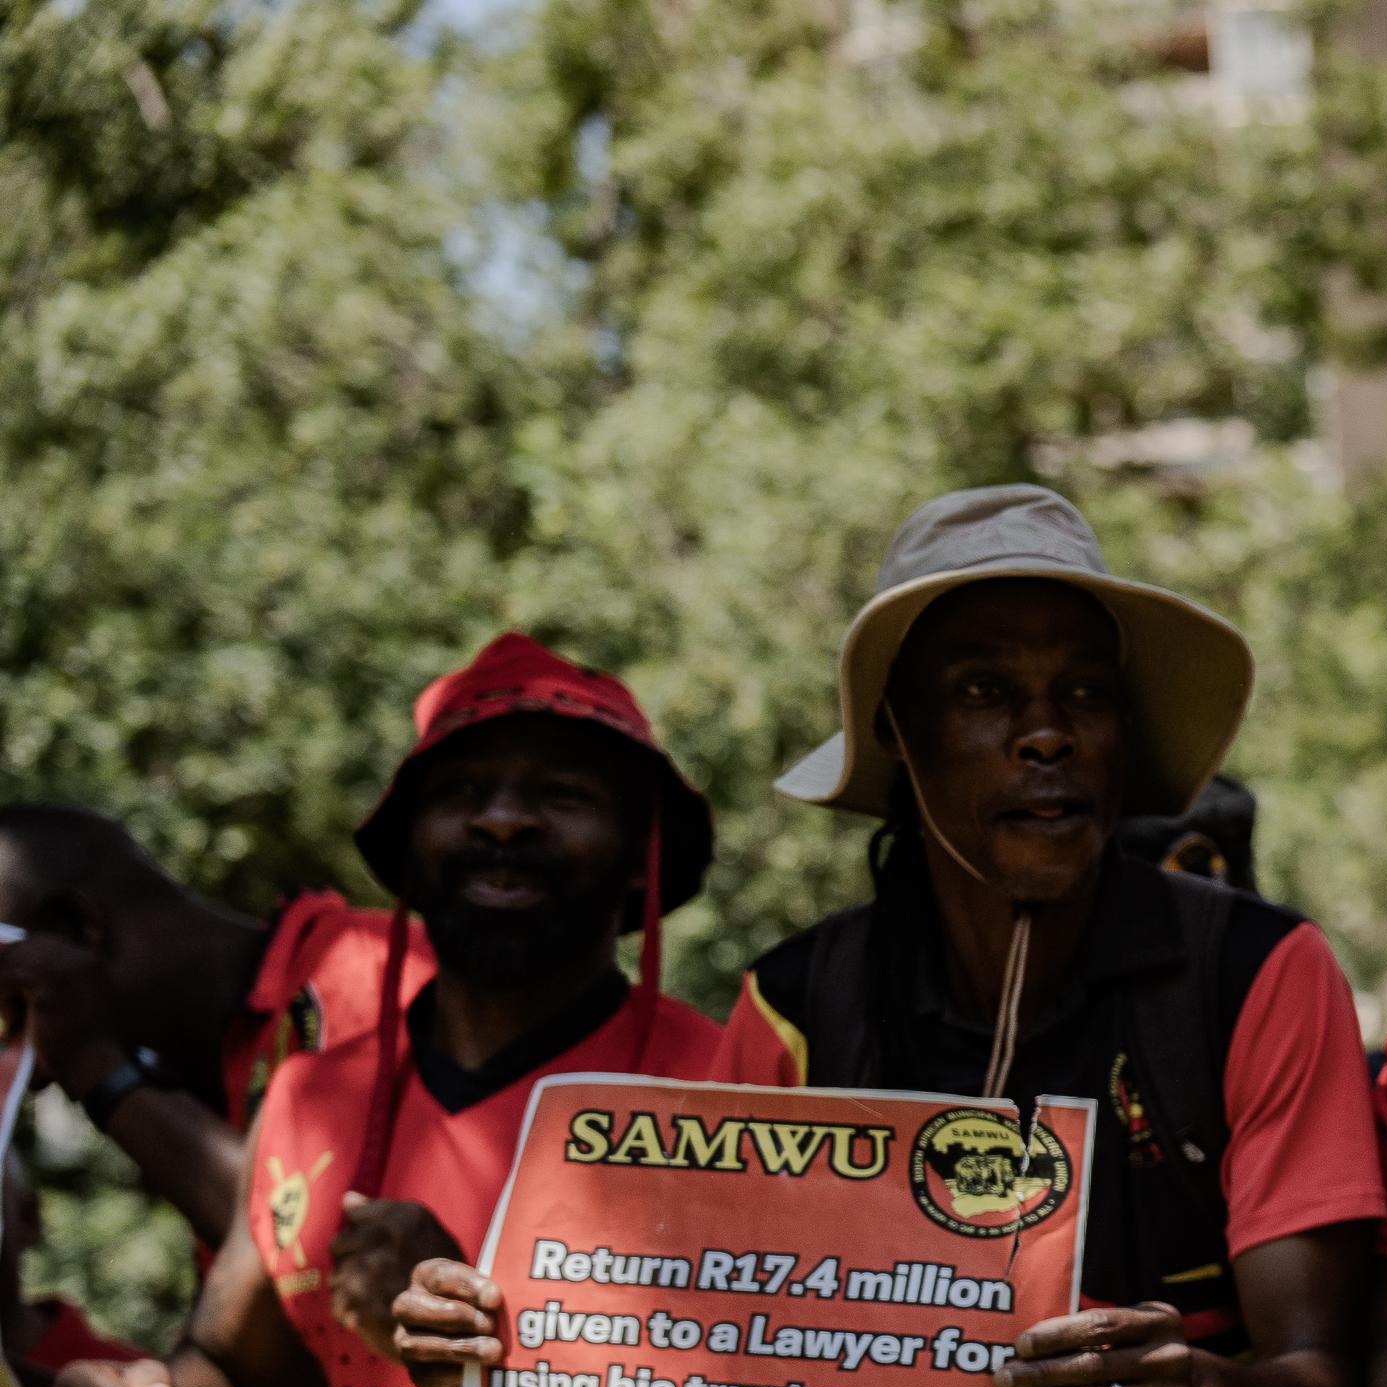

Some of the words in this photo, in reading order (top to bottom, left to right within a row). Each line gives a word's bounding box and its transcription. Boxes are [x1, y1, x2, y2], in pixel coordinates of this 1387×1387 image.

[566, 1110, 892, 1180] SAMWU
[951, 1128, 1010, 1141] SAMWU
[1053, 1160, 1069, 1192] UNION
[530, 1239, 691, 1288] Return
[697, 1250, 840, 1298] R17.4
[847, 1263, 1012, 1312] million
[518, 1300, 641, 1348] given
[648, 1312, 701, 1350] to
[707, 1322, 740, 1353] a
[747, 1315, 924, 1370] Lawyer
[932, 1328, 1015, 1373] for
